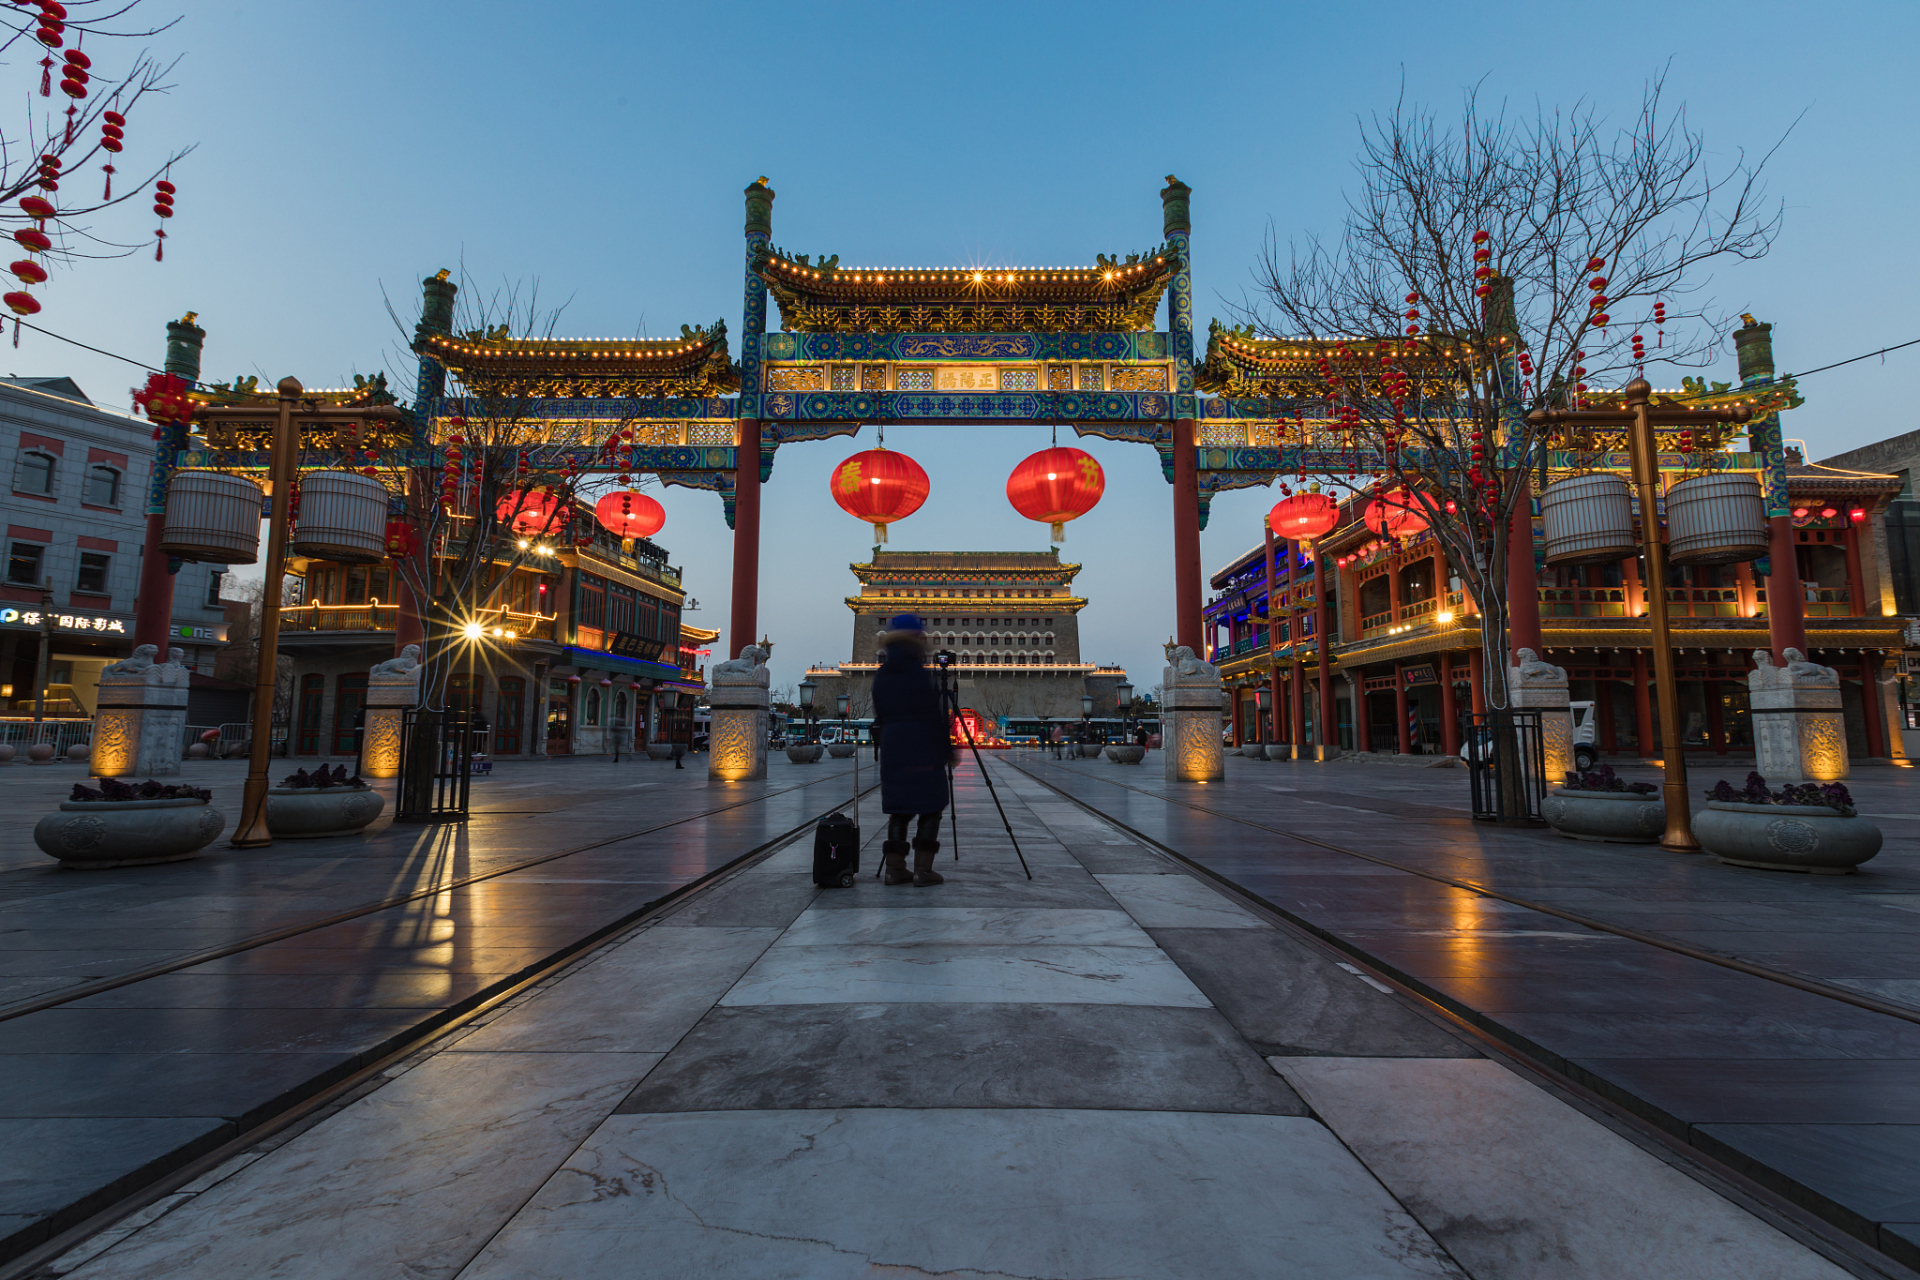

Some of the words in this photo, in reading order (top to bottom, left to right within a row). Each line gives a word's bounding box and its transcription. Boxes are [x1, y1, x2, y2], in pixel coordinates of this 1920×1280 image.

[839, 461, 863, 494] 春
[1077, 456, 1099, 490] 节
[21, 611, 125, 633] 保国际影城
